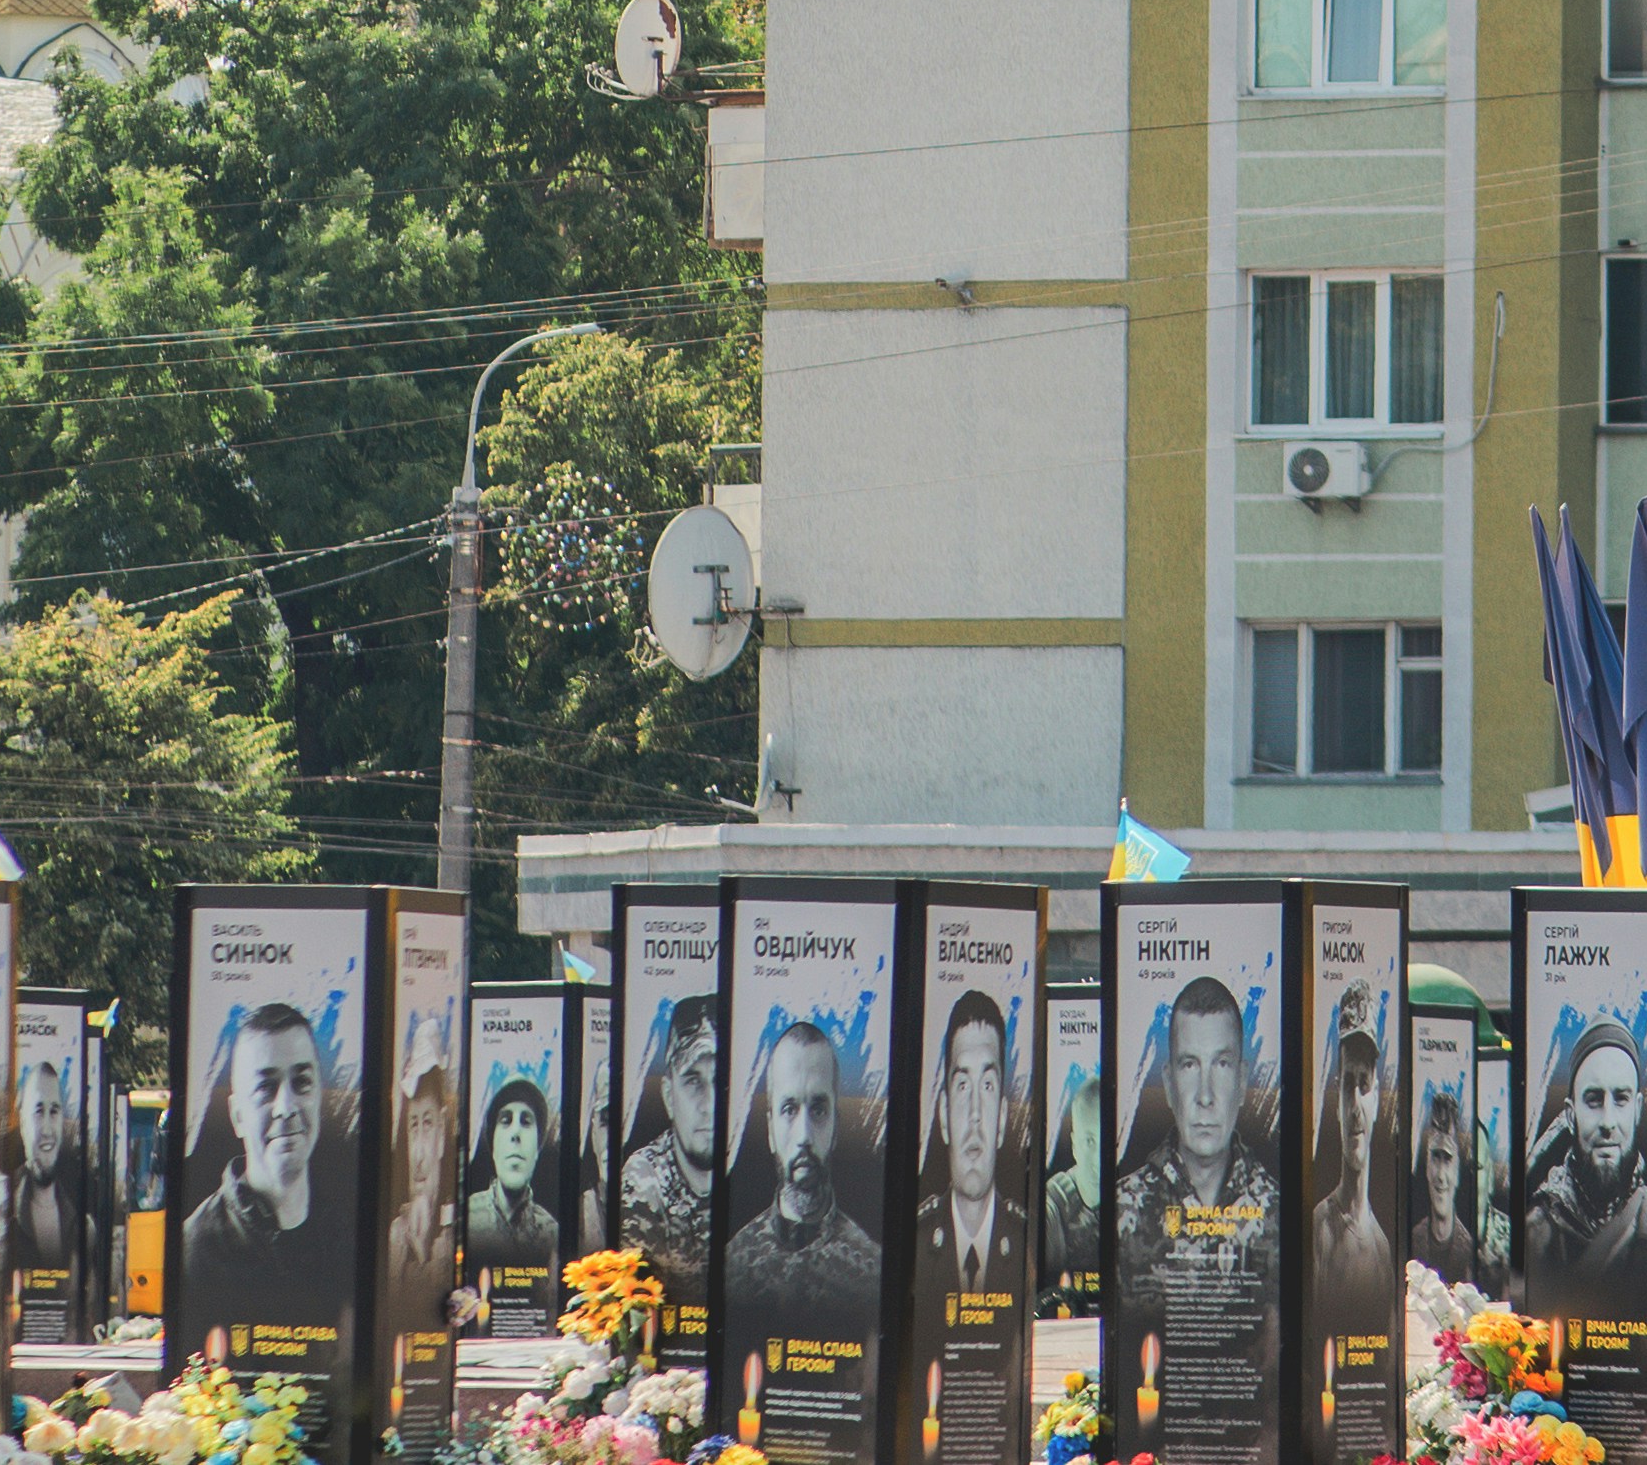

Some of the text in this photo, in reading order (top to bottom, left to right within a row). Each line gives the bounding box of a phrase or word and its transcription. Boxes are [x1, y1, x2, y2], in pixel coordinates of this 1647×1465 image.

[212, 924, 263, 937] ВАСИЛЬ
[644, 920, 706, 934] ОЛЕКСАНДР
[755, 917, 769, 930] ЯН
[1137, 917, 1177, 933] СЕРГІЙ
[1322, 918, 1353, 935] ГРИГОРІЙ
[1544, 924, 1579, 939] СЕРГІЙ
[211, 943, 293, 963] СИНЮК
[644, 939, 718, 964] ПОЛІЩУ
[754, 931, 856, 962] ОВДІЙЧУК
[939, 940, 1013, 965] ВЛАСЕНКО
[1138, 940, 1210, 962] НІКІТІН
[1322, 942, 1365, 964] МАСЮК
[1544, 946, 1610, 967] ЛАЖУК
[1138, 967, 1175, 981] 49 років
[483, 1020, 533, 1034] КРАВЦОВ
[1060, 1021, 1098, 1034] НІКІТІН
[1185, 1205, 1264, 1221] ВІЧНА СЛАВА
[1185, 1221, 1237, 1237] ГЕРОЯМ!
[1585, 1319, 1617, 1335] ВІЧНА
[786, 1339, 863, 1358] ВІЧНА СЛАВА
[1585, 1335, 1630, 1350] ГЕРОЯМ!
